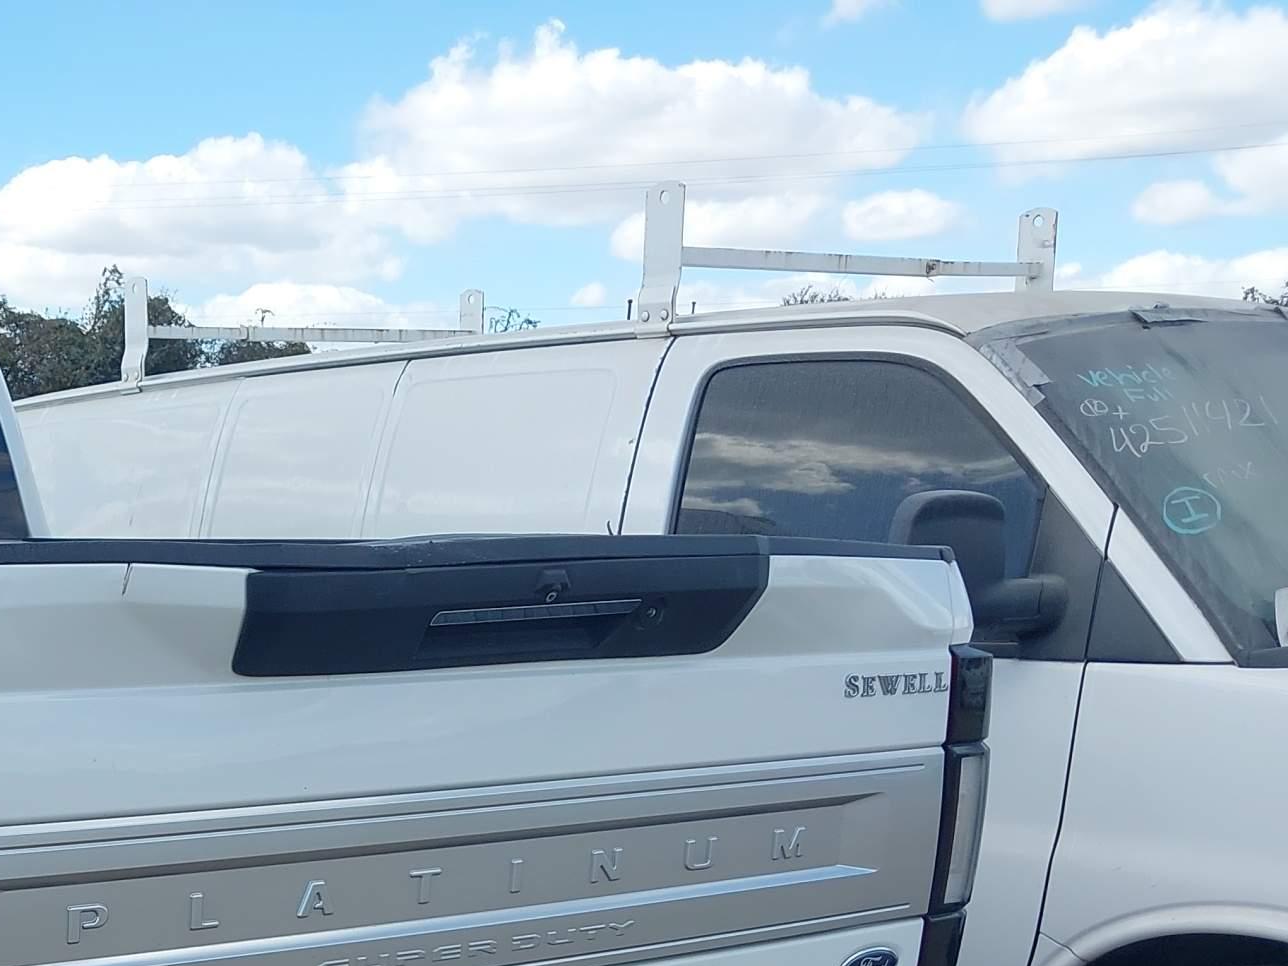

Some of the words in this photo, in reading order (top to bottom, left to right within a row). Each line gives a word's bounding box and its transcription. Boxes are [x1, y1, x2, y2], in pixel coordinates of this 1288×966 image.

[844, 671, 950, 698] SEWELL
[66, 825, 807, 945] PLATINUM
[511, 919, 636, 952] DUTY
